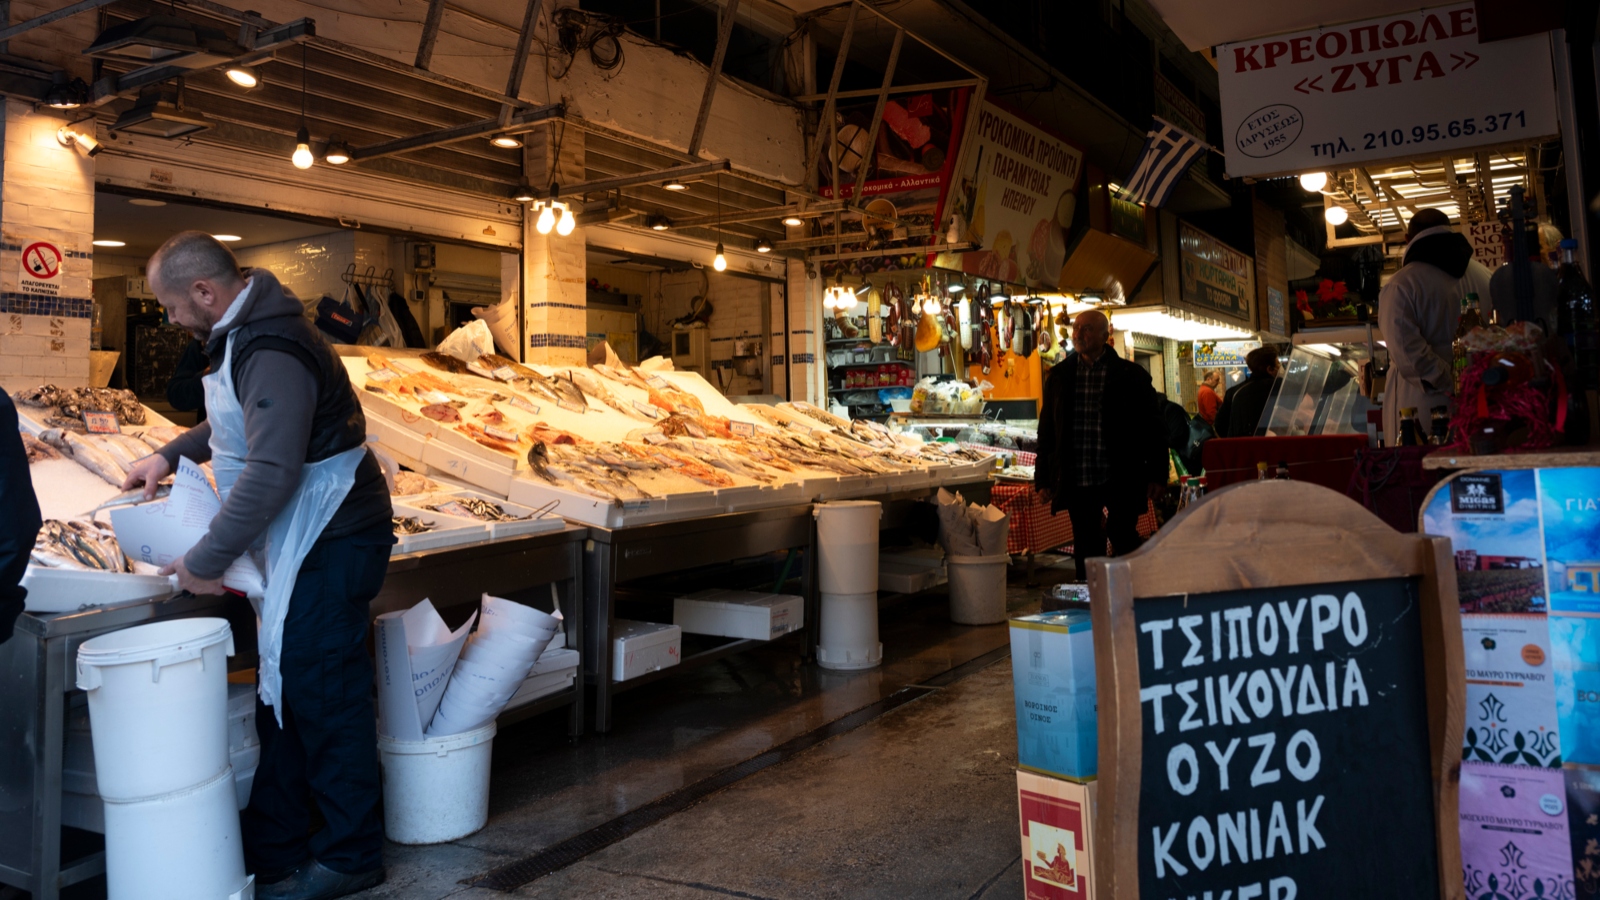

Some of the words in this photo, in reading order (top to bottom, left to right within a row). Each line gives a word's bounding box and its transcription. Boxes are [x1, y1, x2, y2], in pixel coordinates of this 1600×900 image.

[1234, 8, 1478, 73] ΚΡΕΟΠΩΛΕ
[1240, 113, 1299, 148] ΙΔΡΥΣΕΩΣ
[1247, 109, 1280, 130] ΕΤΟΣ
[977, 109, 1036, 160] ΥΡΟΚΟΜΙΚΑ
[1263, 133, 1287, 150] 1955
[1311, 136, 1355, 159] τηλ.
[1363, 110, 1526, 150] 210.95.65.371
[824, 189, 844, 197] Ελς
[851, 182, 893, 194] Τοκομικά
[900, 177, 940, 188] Αλλαντικά
[992, 153, 1051, 197] ΠΑΡΑΜΥΘΙΑΣ
[1001, 187, 1037, 216] ΗΠΕΙΡΟΥ
[1470, 222, 1512, 236] ΚΡΕΑ
[1474, 234, 1502, 246] ΝΩ
[21, 280, 60, 289] ΑΠΑΓΟΡΕΥΕΤΑΙ
[1140, 591, 1369, 670] ΤΣΙΠΟΥΡΟ
[1476, 670, 1504, 679] ΜΑΥΡΟ
[1505, 672, 1547, 682] ΤΥΡΝΑΒΟΥ
[1024, 700, 1058, 713] ΒΟΡΟΙΝΟΣ
[1140, 658, 1370, 734] ΤΣΙΚΟΥΔΙΑ
[1030, 713, 1052, 723] ΟΙΝΟΣ
[1166, 729, 1321, 796] ΟΥΖΟ
[1460, 813, 1496, 824] ΜΟΣΧΑΤΟ
[1496, 816, 1523, 827] ΜΑΥΡΟ
[1524, 819, 1564, 830] ΤΥΡΝΑΒΟΥ
[1152, 795, 1327, 879] ΚΟΝΙΑΚ
